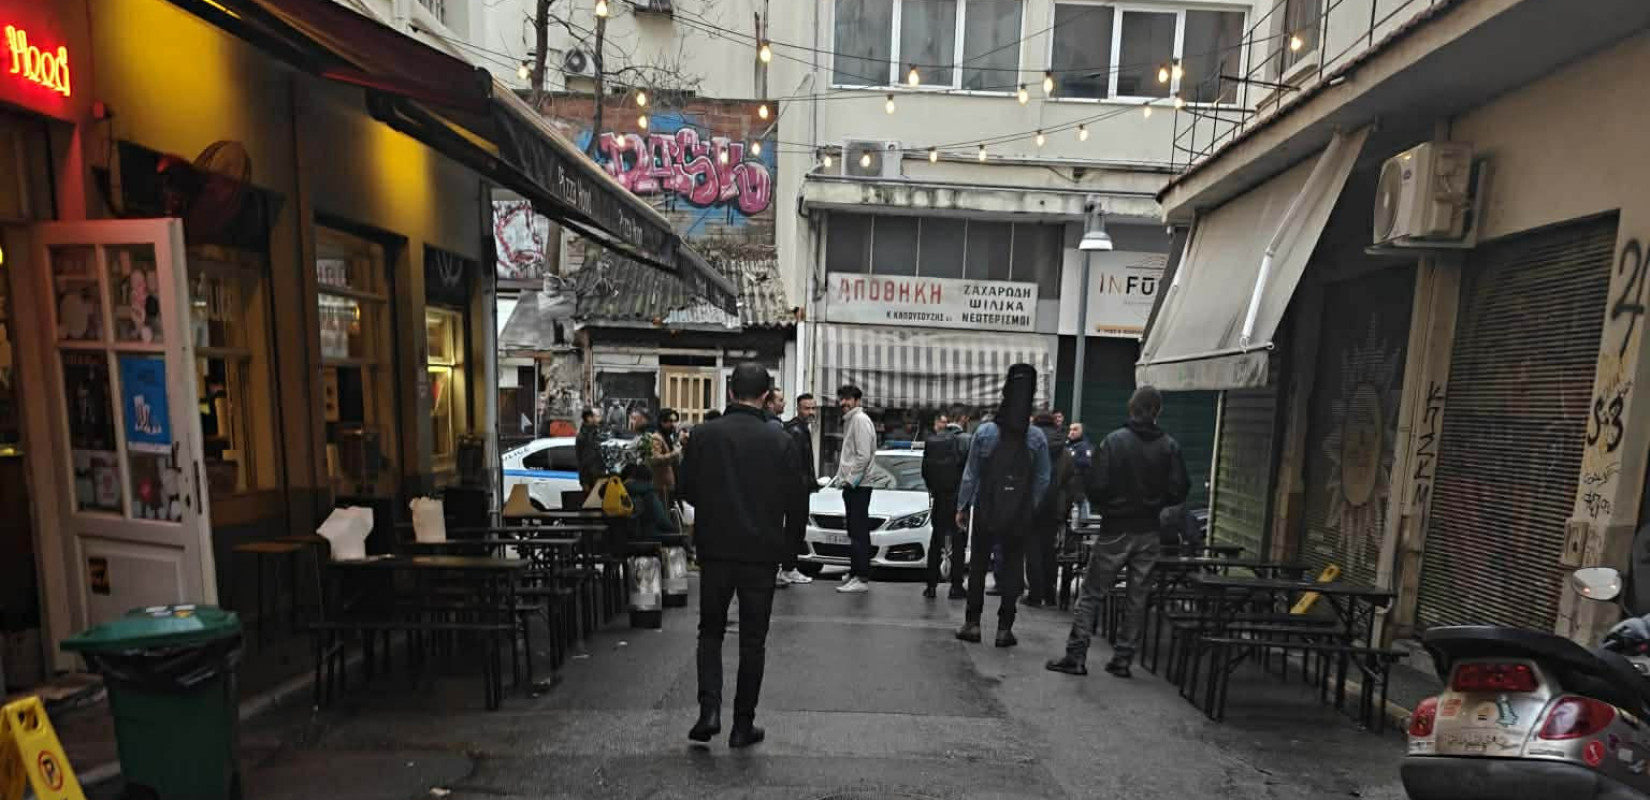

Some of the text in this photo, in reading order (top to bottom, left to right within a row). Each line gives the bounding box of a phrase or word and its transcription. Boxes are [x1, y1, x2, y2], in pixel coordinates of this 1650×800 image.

[840, 278, 942, 305] ΑΠΟΘΗΚΗ
[963, 284, 1032, 299] ΖΑΧΑΡΩΔΗ
[961, 312, 1030, 326] ΝΕΩΤΕΡΙΣΜΟΙ
